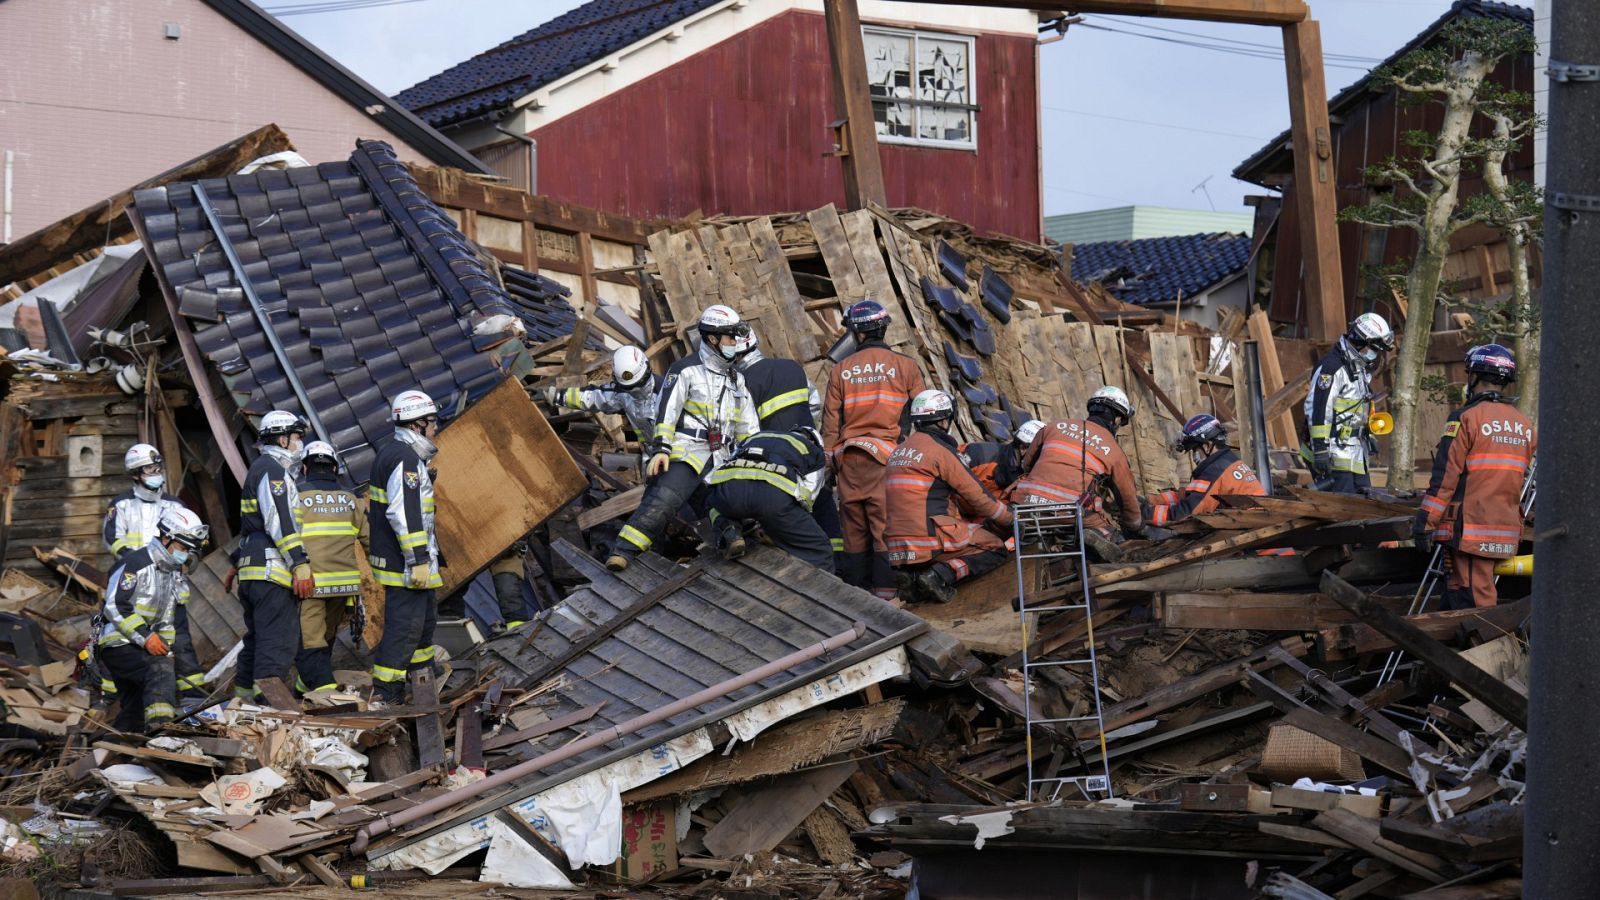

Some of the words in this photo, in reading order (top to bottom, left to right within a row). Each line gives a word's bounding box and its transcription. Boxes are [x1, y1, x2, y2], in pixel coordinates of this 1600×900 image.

[841, 362, 896, 378] OSAKA
[1056, 422, 1111, 456] OSAKA
[1481, 420, 1532, 442] OSAKA
[303, 494, 356, 511] OSAKA
